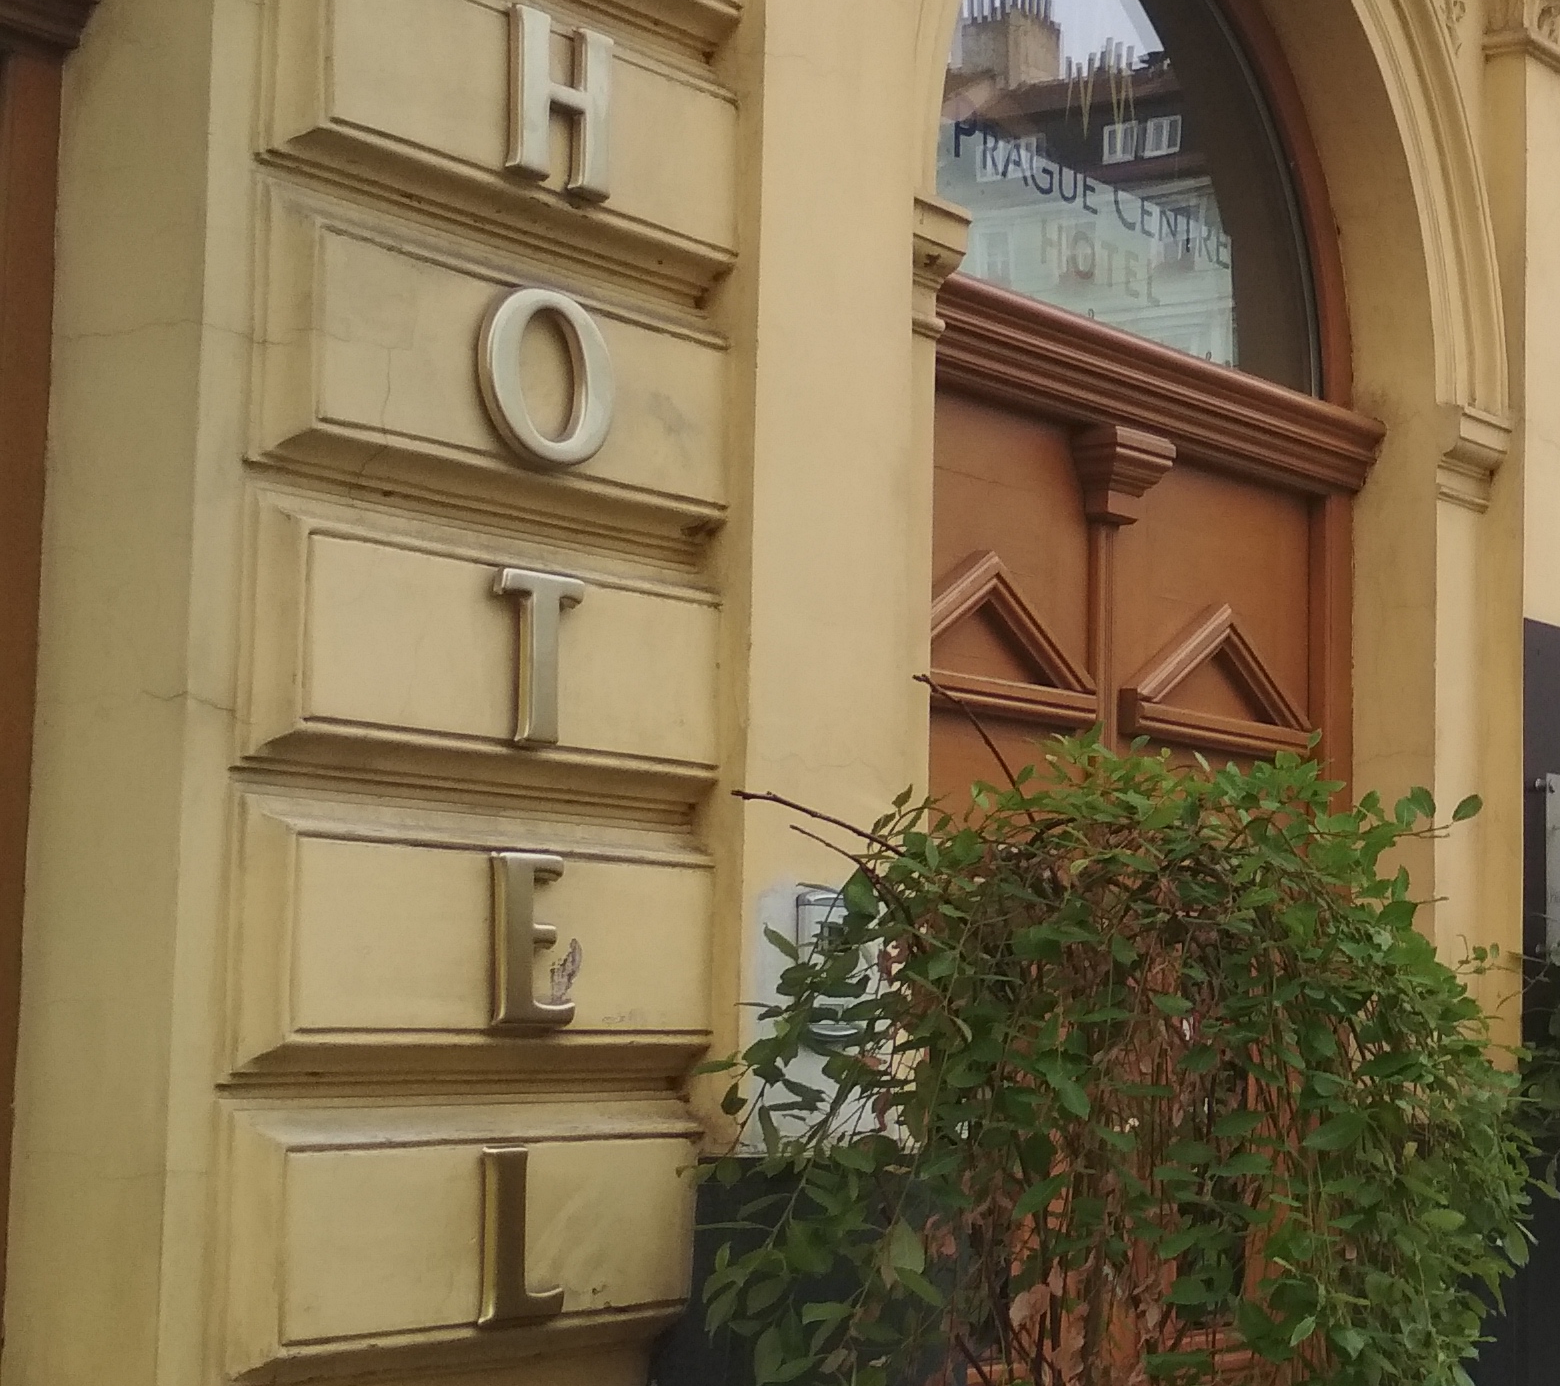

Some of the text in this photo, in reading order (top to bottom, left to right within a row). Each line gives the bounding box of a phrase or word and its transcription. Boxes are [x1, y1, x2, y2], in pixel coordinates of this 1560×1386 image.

[953, 111, 1231, 270] PRAGUE CENTRE
[1040, 217, 1160, 307] HOTEL
[476, 1, 616, 1329] HOTEL
